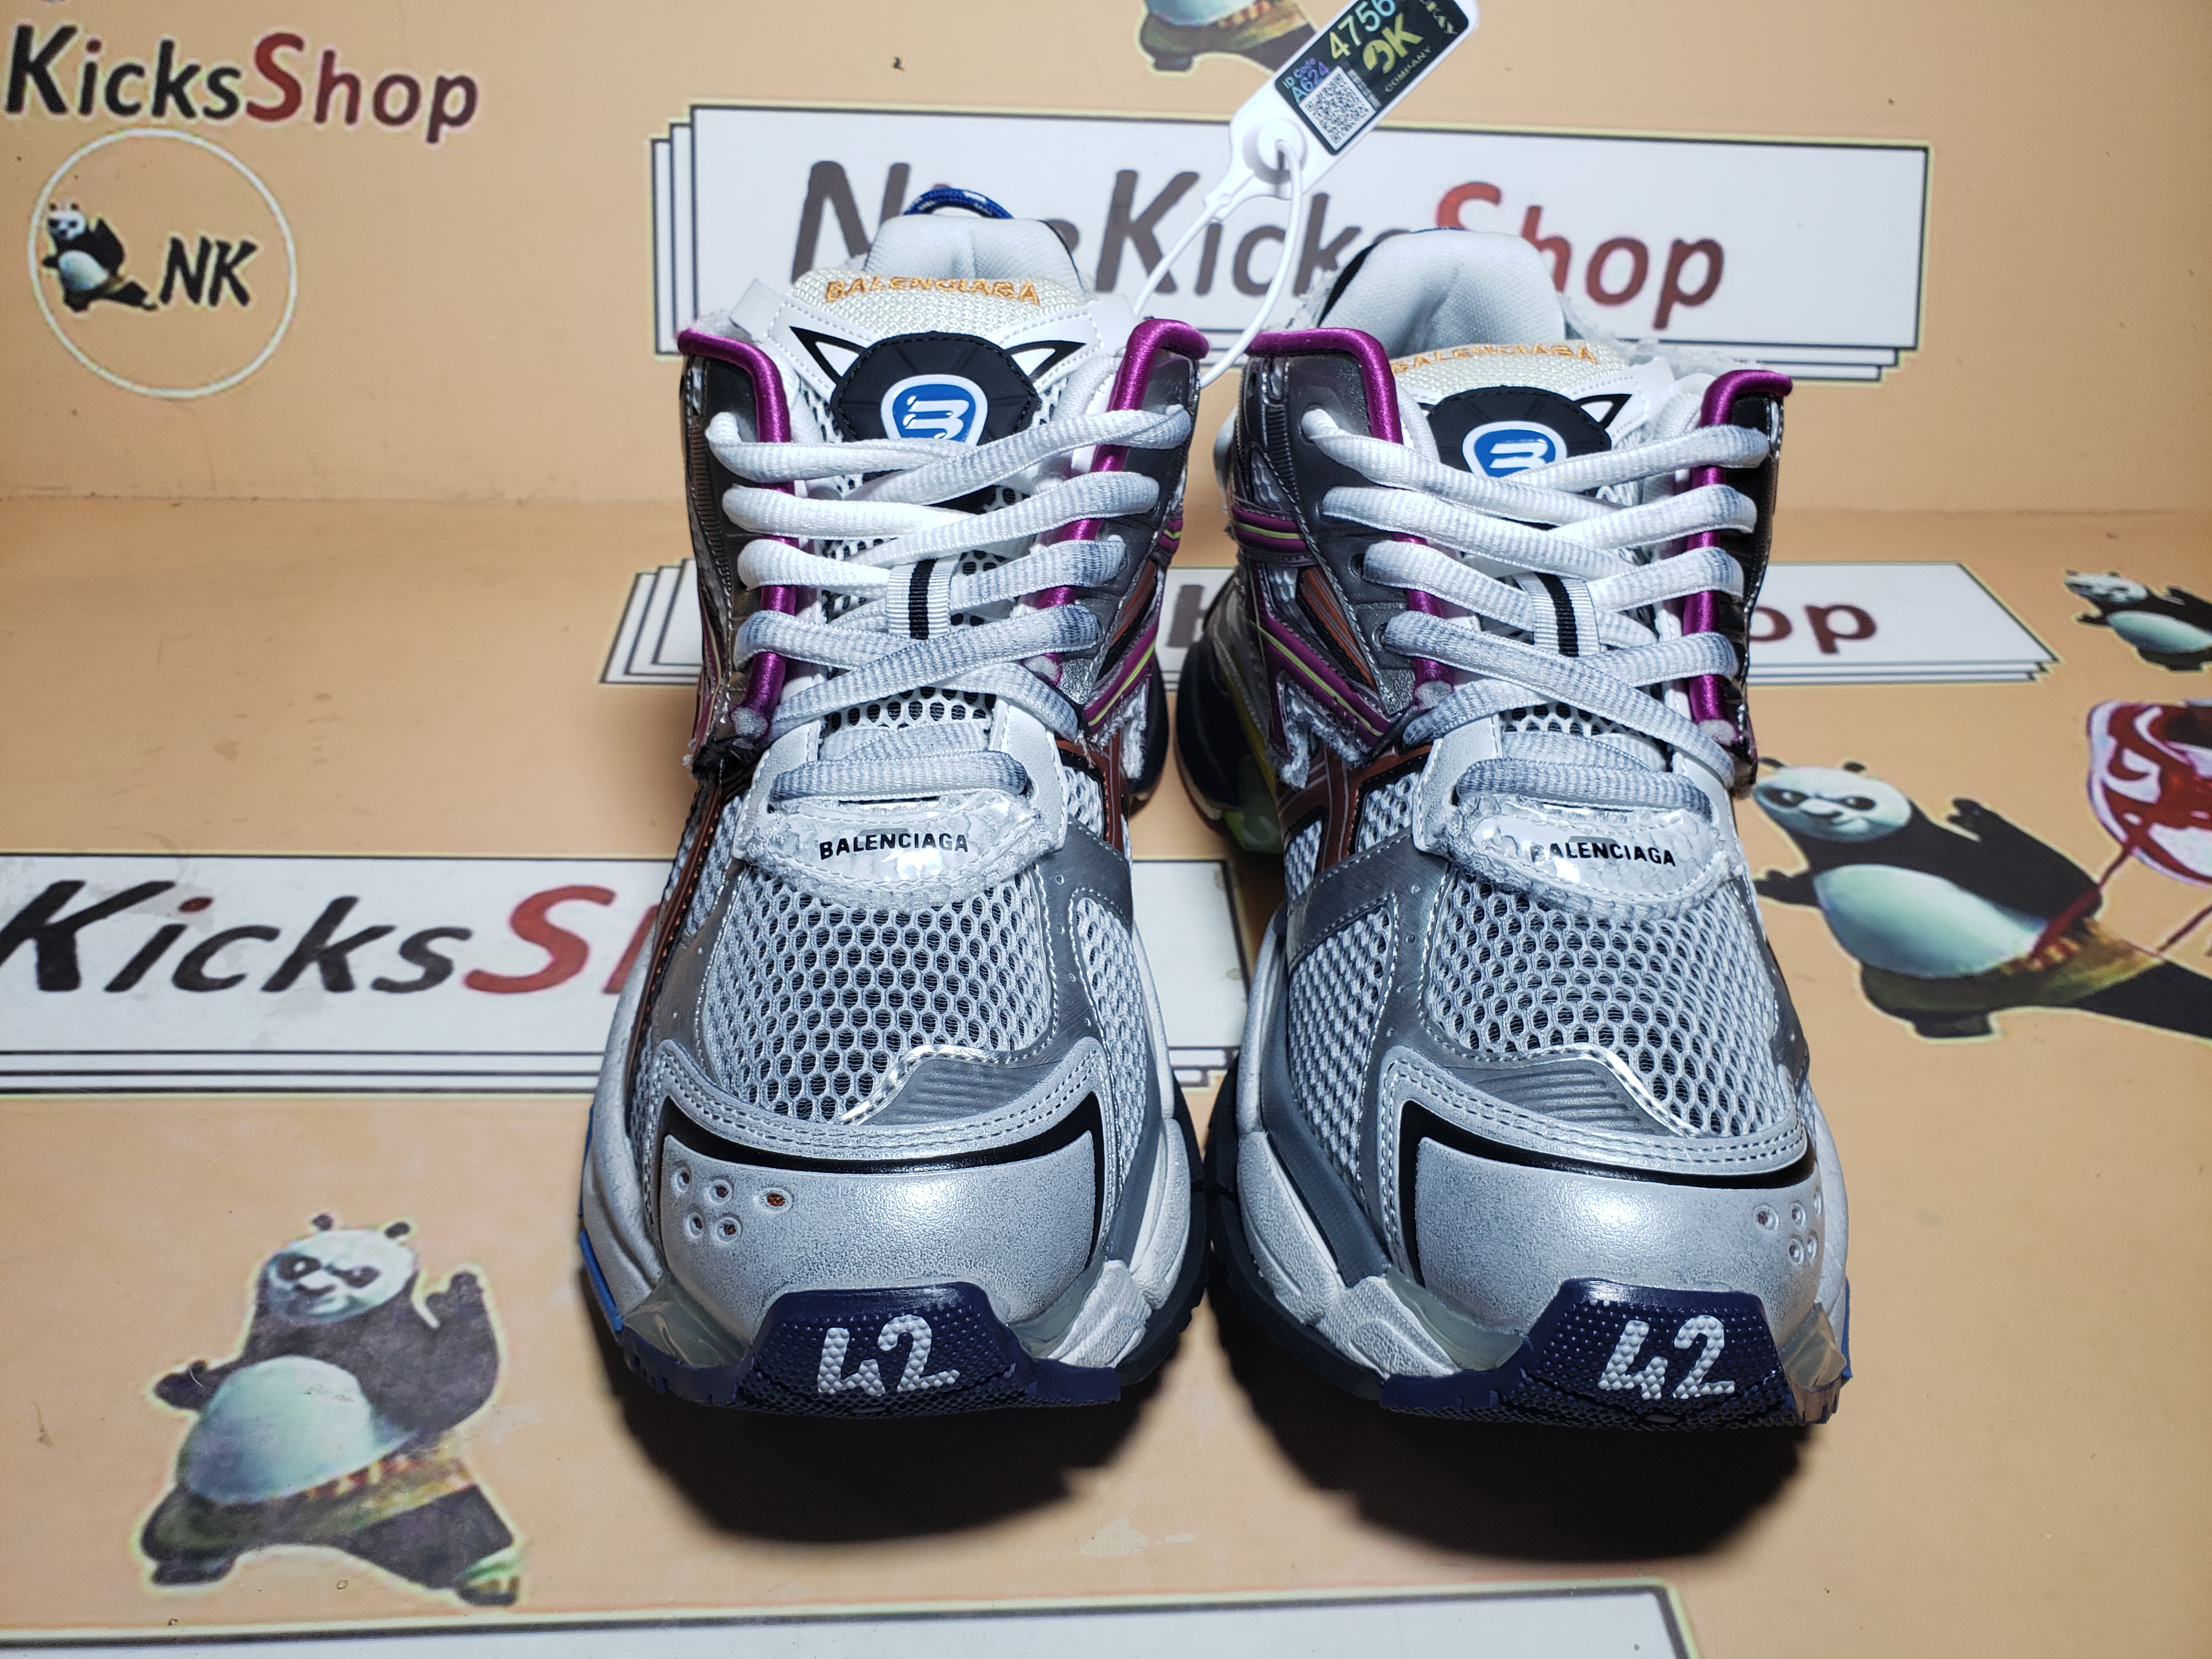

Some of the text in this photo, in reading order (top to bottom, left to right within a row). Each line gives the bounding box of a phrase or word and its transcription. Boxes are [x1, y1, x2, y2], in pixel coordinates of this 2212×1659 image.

[5, 24, 478, 143] KicksShop
[160, 237, 257, 307] NK
[825, 276, 1041, 306] BALENCIAGA
[819, 833, 969, 860] BALENCIAGA
[817, 1315, 960, 1397] 42
[1596, 1314, 1735, 1400] 42
